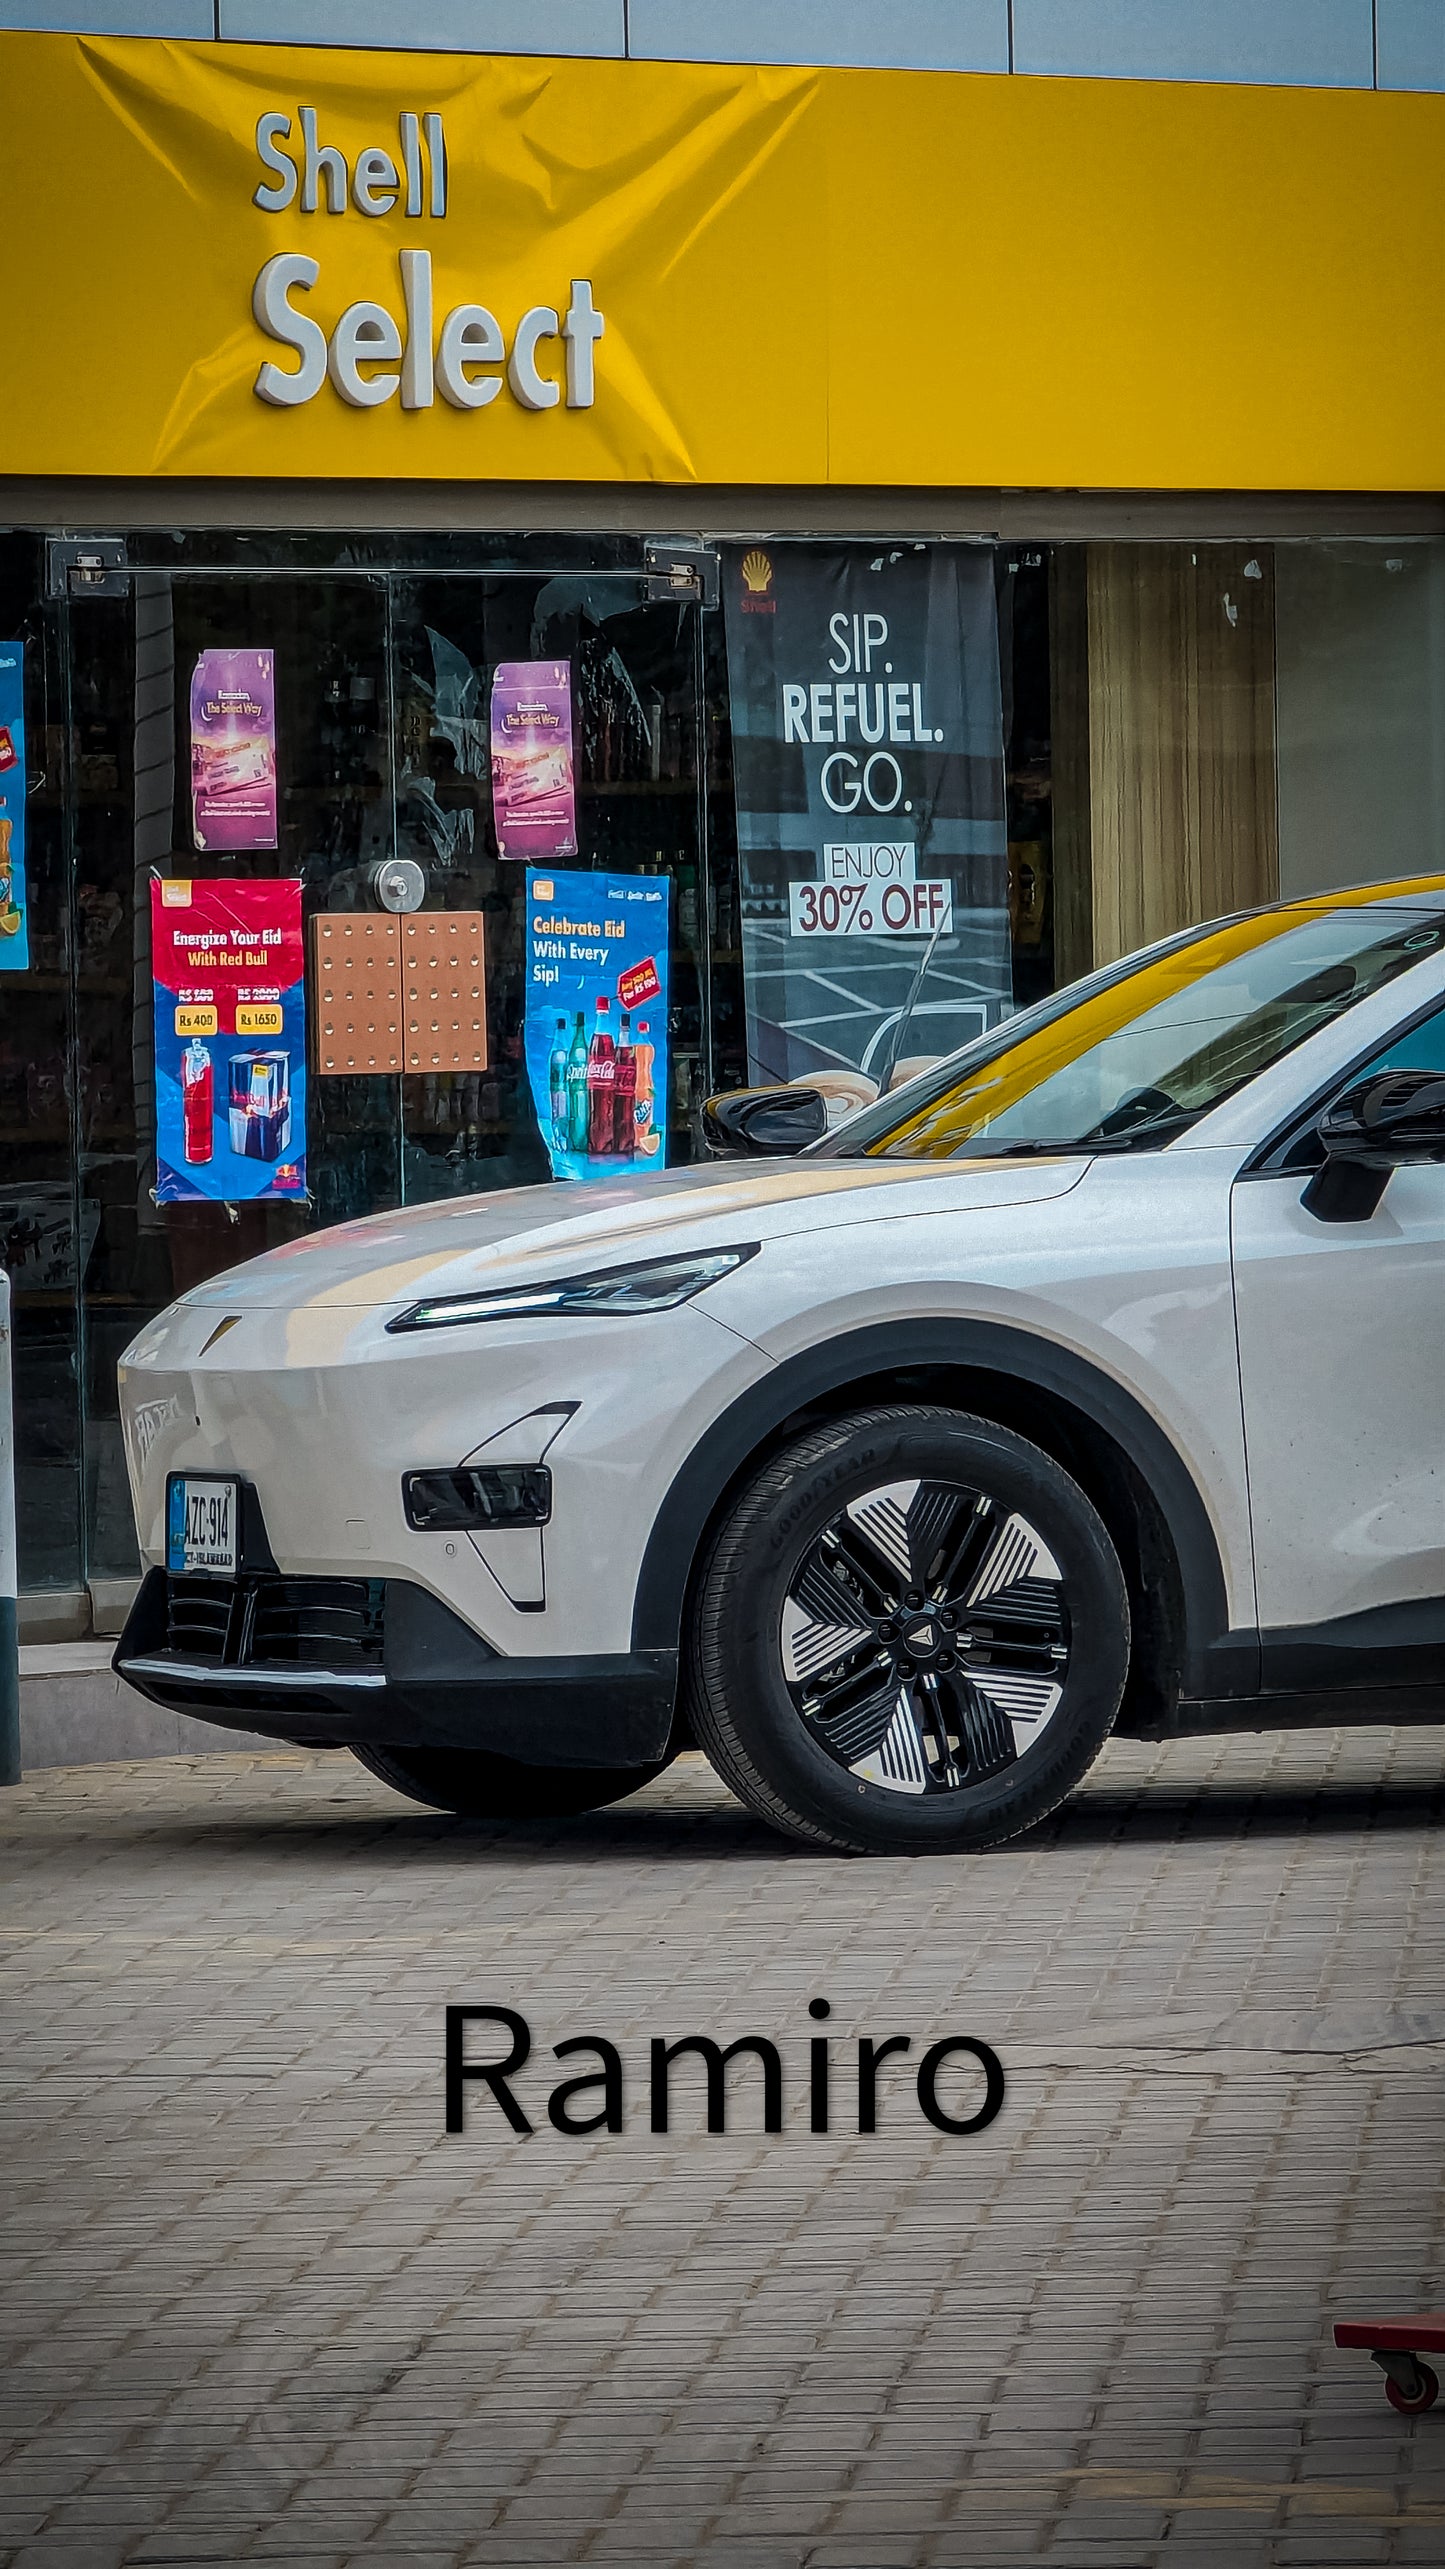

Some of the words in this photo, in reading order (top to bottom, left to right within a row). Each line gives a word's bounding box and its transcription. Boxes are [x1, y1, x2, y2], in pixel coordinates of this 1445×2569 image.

[252, 106, 448, 218] Shell
[252, 248, 604, 411] Select
[828, 612, 893, 675] SIP.
[782, 683, 944, 743] REFUEL.
[820, 751, 913, 813] GO.
[831, 845, 907, 878] ENJOY
[799, 883, 874, 933] 30%
[881, 884, 944, 930] OFF
[229, 929, 260, 946] Your
[262, 927, 282, 945] Eid
[533, 916, 601, 937] Celebrate
[604, 920, 625, 938] Eid
[188, 951, 217, 967] With
[219, 951, 243, 966] Red
[245, 950, 268, 966] Bull
[533, 940, 566, 959] With
[569, 942, 609, 966] Every
[180, 1015, 192, 1026] Rs
[193, 1014, 213, 1026] 400
[241, 1014, 252, 1026] Rs
